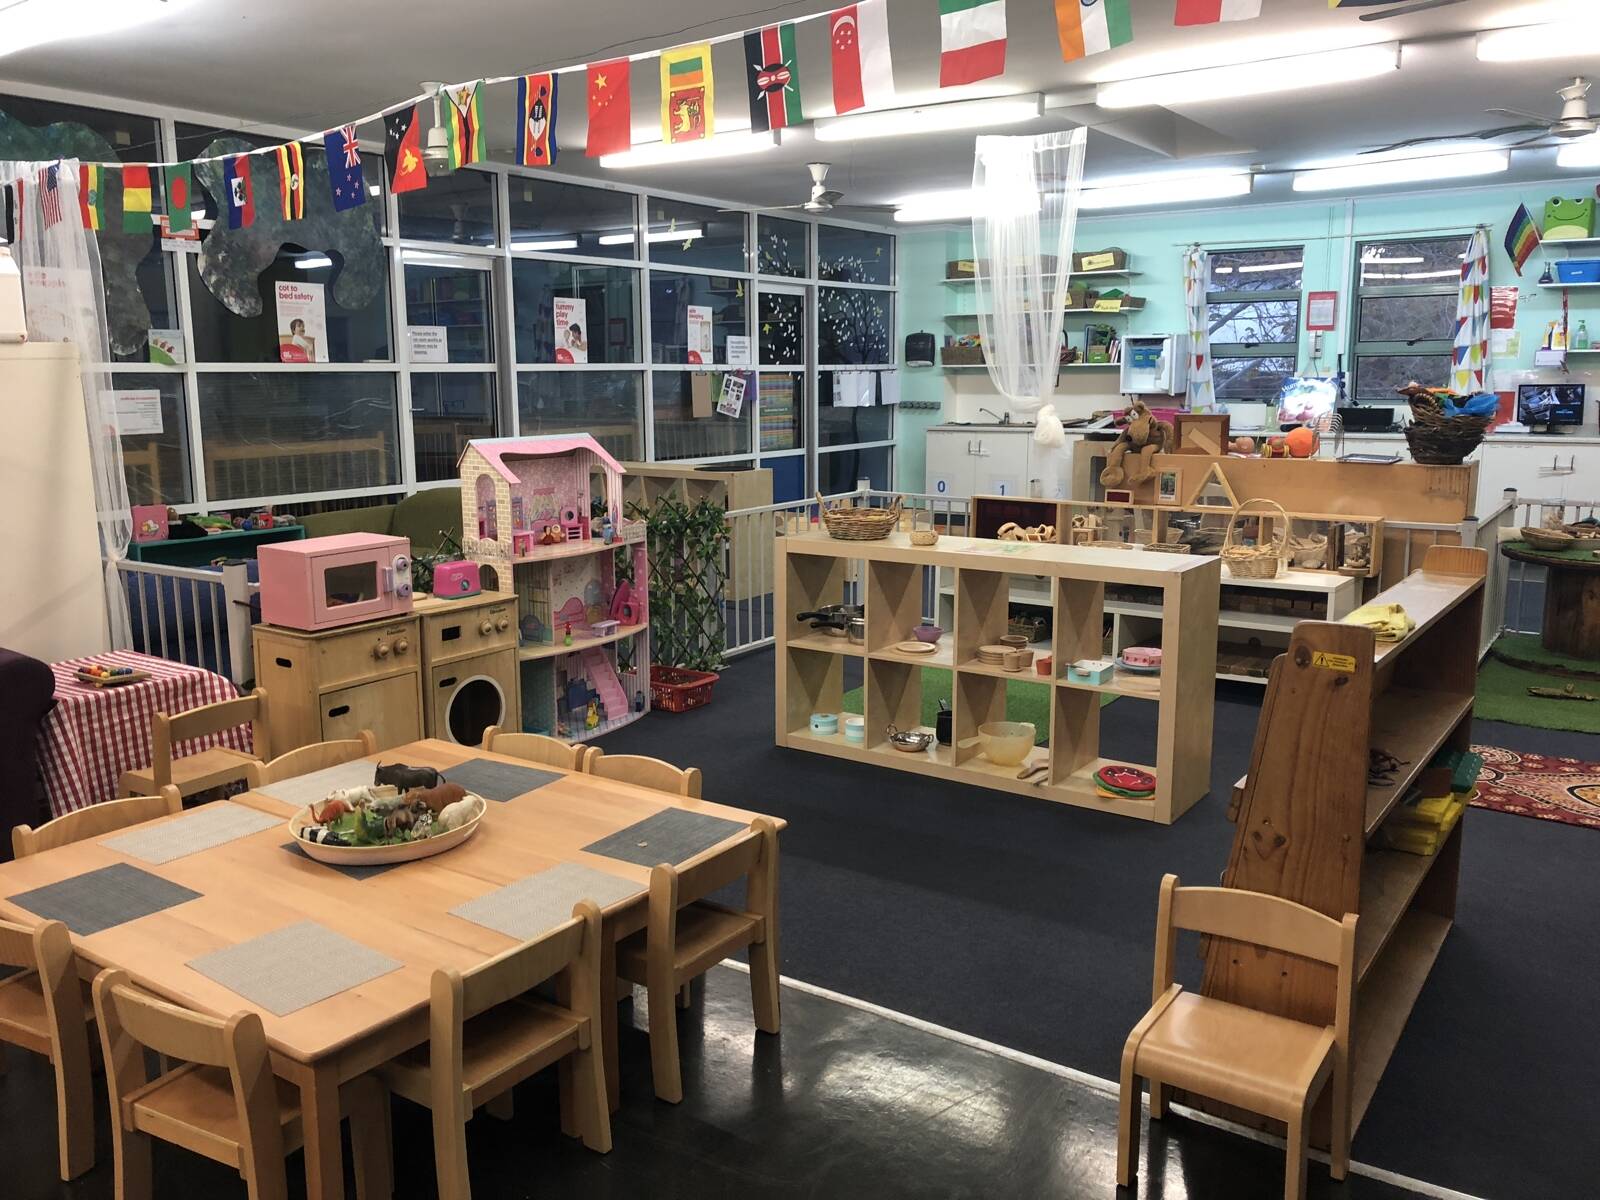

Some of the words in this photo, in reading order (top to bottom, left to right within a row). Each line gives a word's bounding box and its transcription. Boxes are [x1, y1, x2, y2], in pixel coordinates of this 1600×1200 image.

[294, 293, 314, 302] safety
[555, 304, 575, 312] tummy
[556, 311, 569, 320] play
[937, 480, 946, 493] 0
[999, 484, 1005, 496] 1
